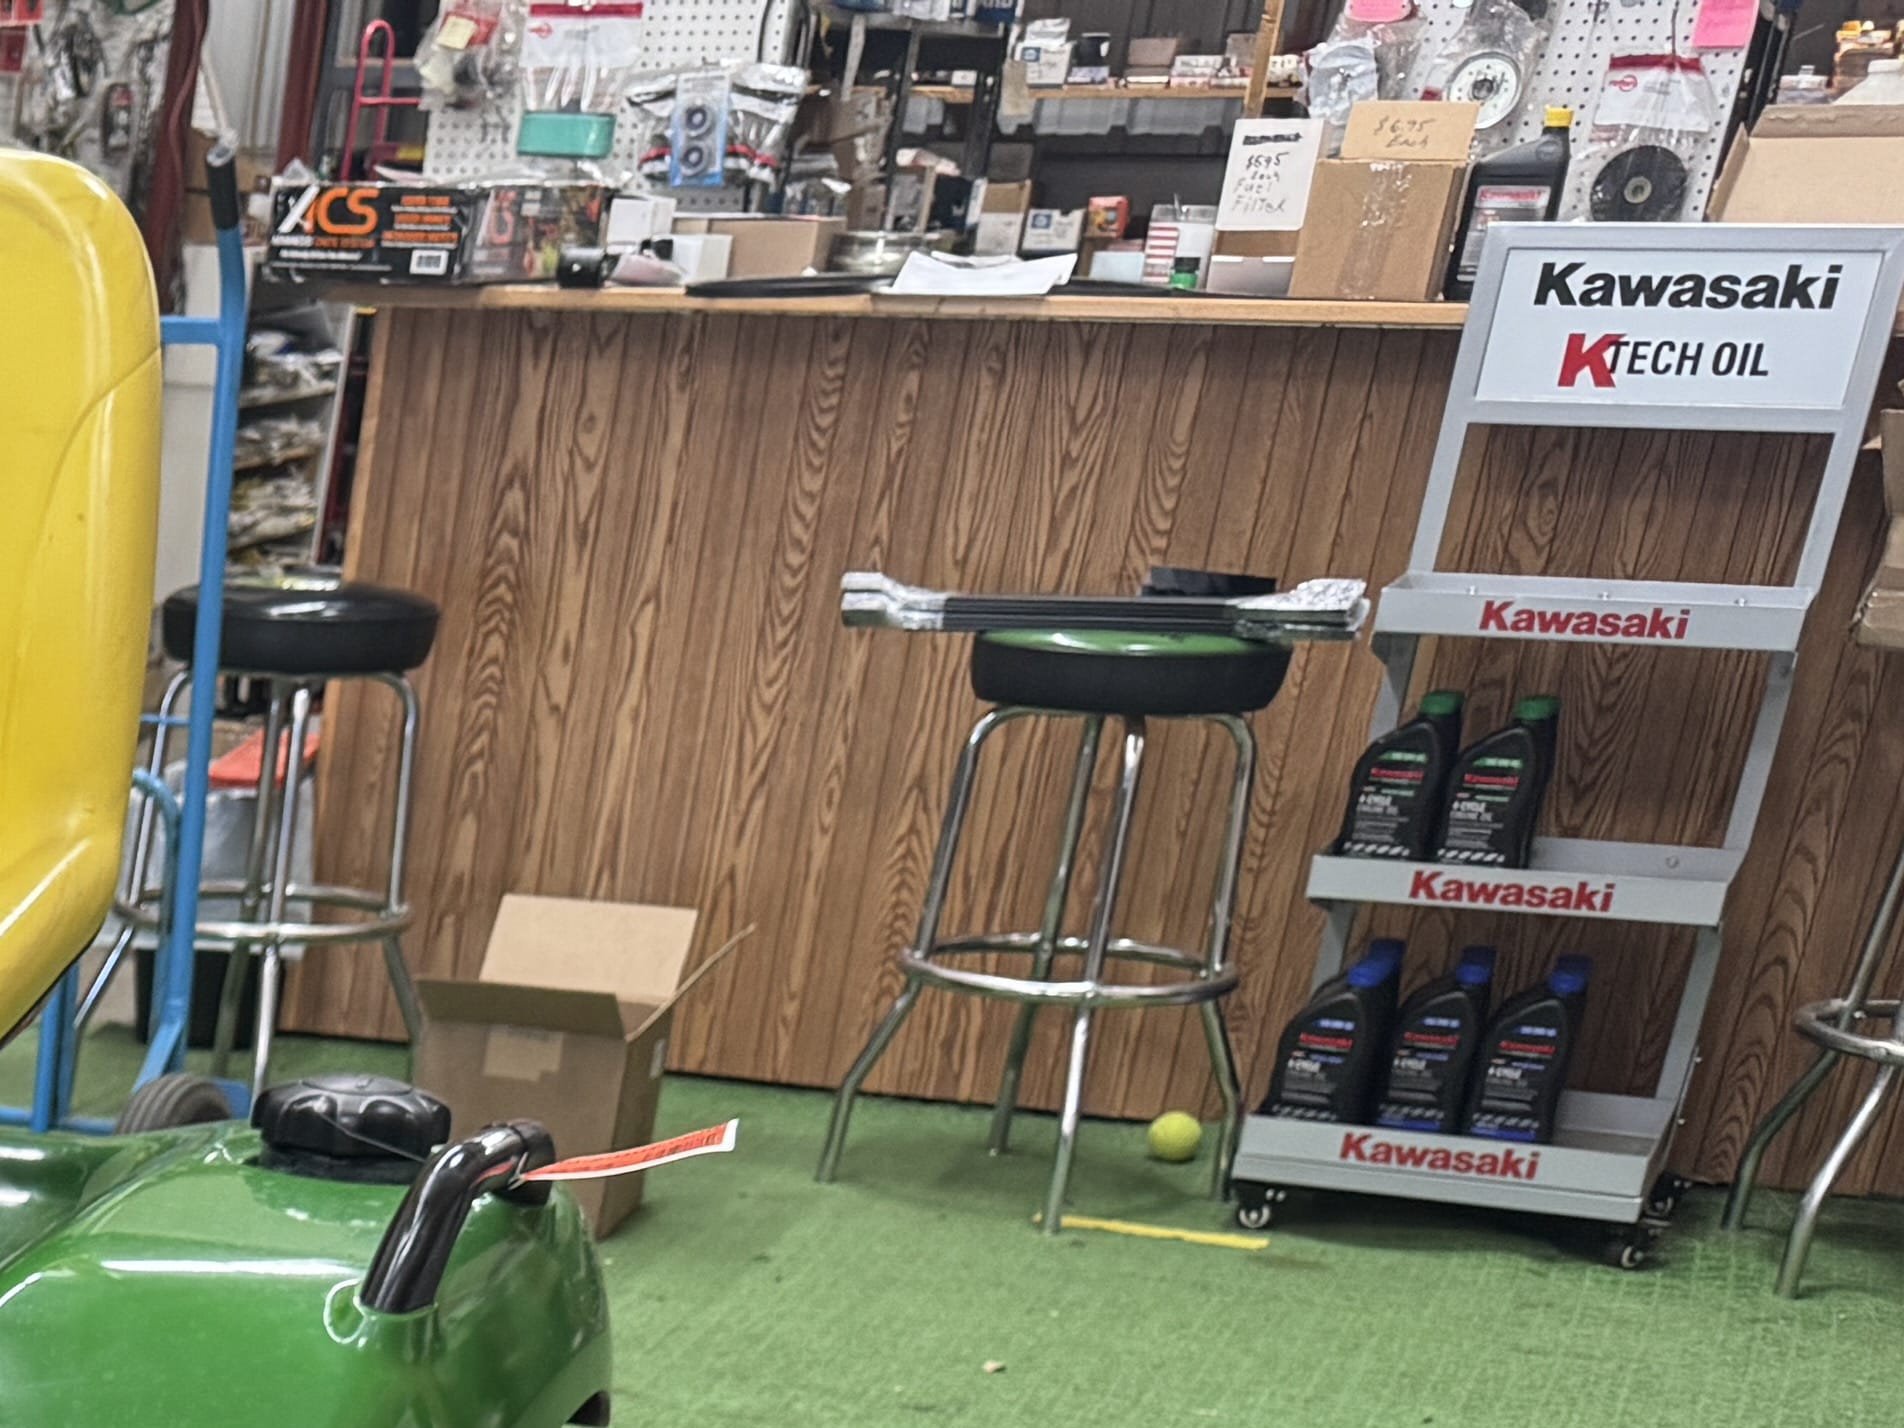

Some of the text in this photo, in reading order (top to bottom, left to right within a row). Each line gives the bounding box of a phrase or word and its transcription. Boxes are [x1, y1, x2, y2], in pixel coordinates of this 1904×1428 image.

[1533, 261, 1844, 309] Kawasaki
[1711, 341, 1769, 377] OIL
[1478, 600, 1691, 640] Kawasaki
[1409, 869, 1616, 914] Kawasaki
[1339, 1131, 1541, 1182] Kawasaki
